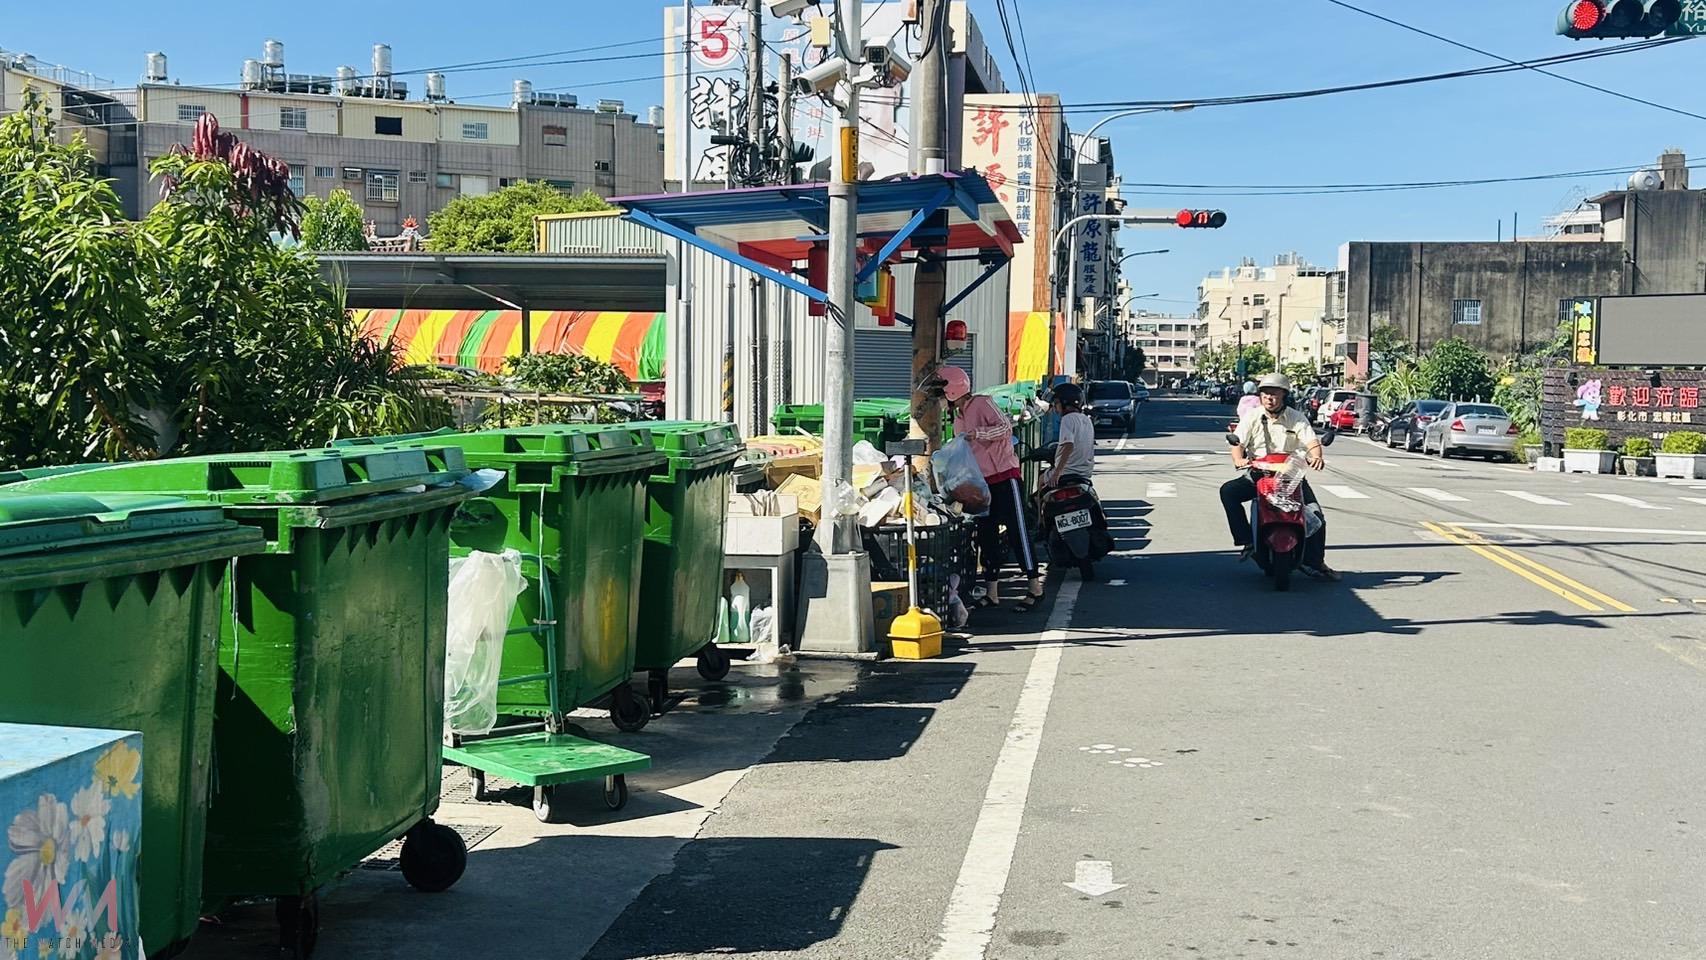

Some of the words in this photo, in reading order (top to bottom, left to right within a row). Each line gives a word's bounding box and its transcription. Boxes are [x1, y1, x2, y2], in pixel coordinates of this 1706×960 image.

[1682, 0, 1706, 21] 裕
[701, 20, 729, 59] 5
[1607, 386, 1698, 408] 歡迎蒞臨
